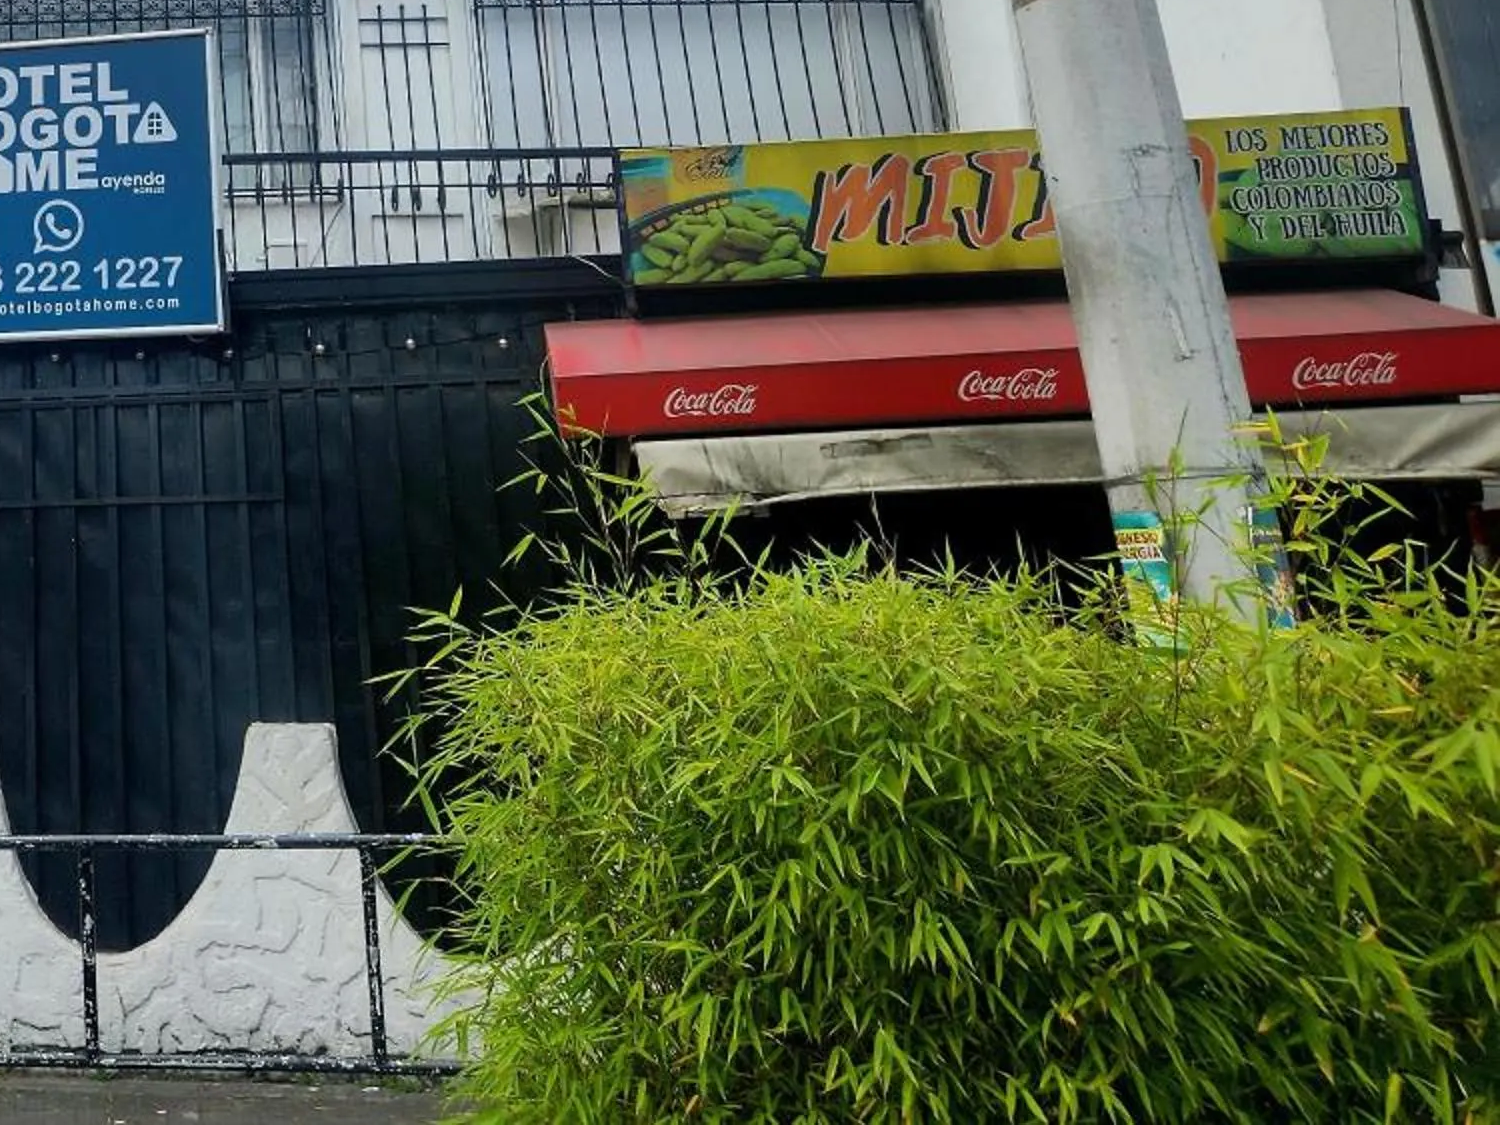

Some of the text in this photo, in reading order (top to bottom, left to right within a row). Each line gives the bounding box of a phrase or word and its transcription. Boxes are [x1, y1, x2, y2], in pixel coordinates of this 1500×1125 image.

[1224, 122, 1390, 154] LOS MEJORES
[101, 171, 165, 191] ayenda
[1256, 152, 1396, 181] PRODUCTOS
[1230, 181, 1402, 214] COLOMBIANOS
[1248, 210, 1409, 242] Y DEL HUILA
[15, 260, 81, 293] 222
[93, 256, 183, 290] 1227
[957, 367, 1058, 402] Coca-Cola
[1291, 351, 1398, 390] Coca-Cola
[663, 383, 758, 419] Coca-Cola
